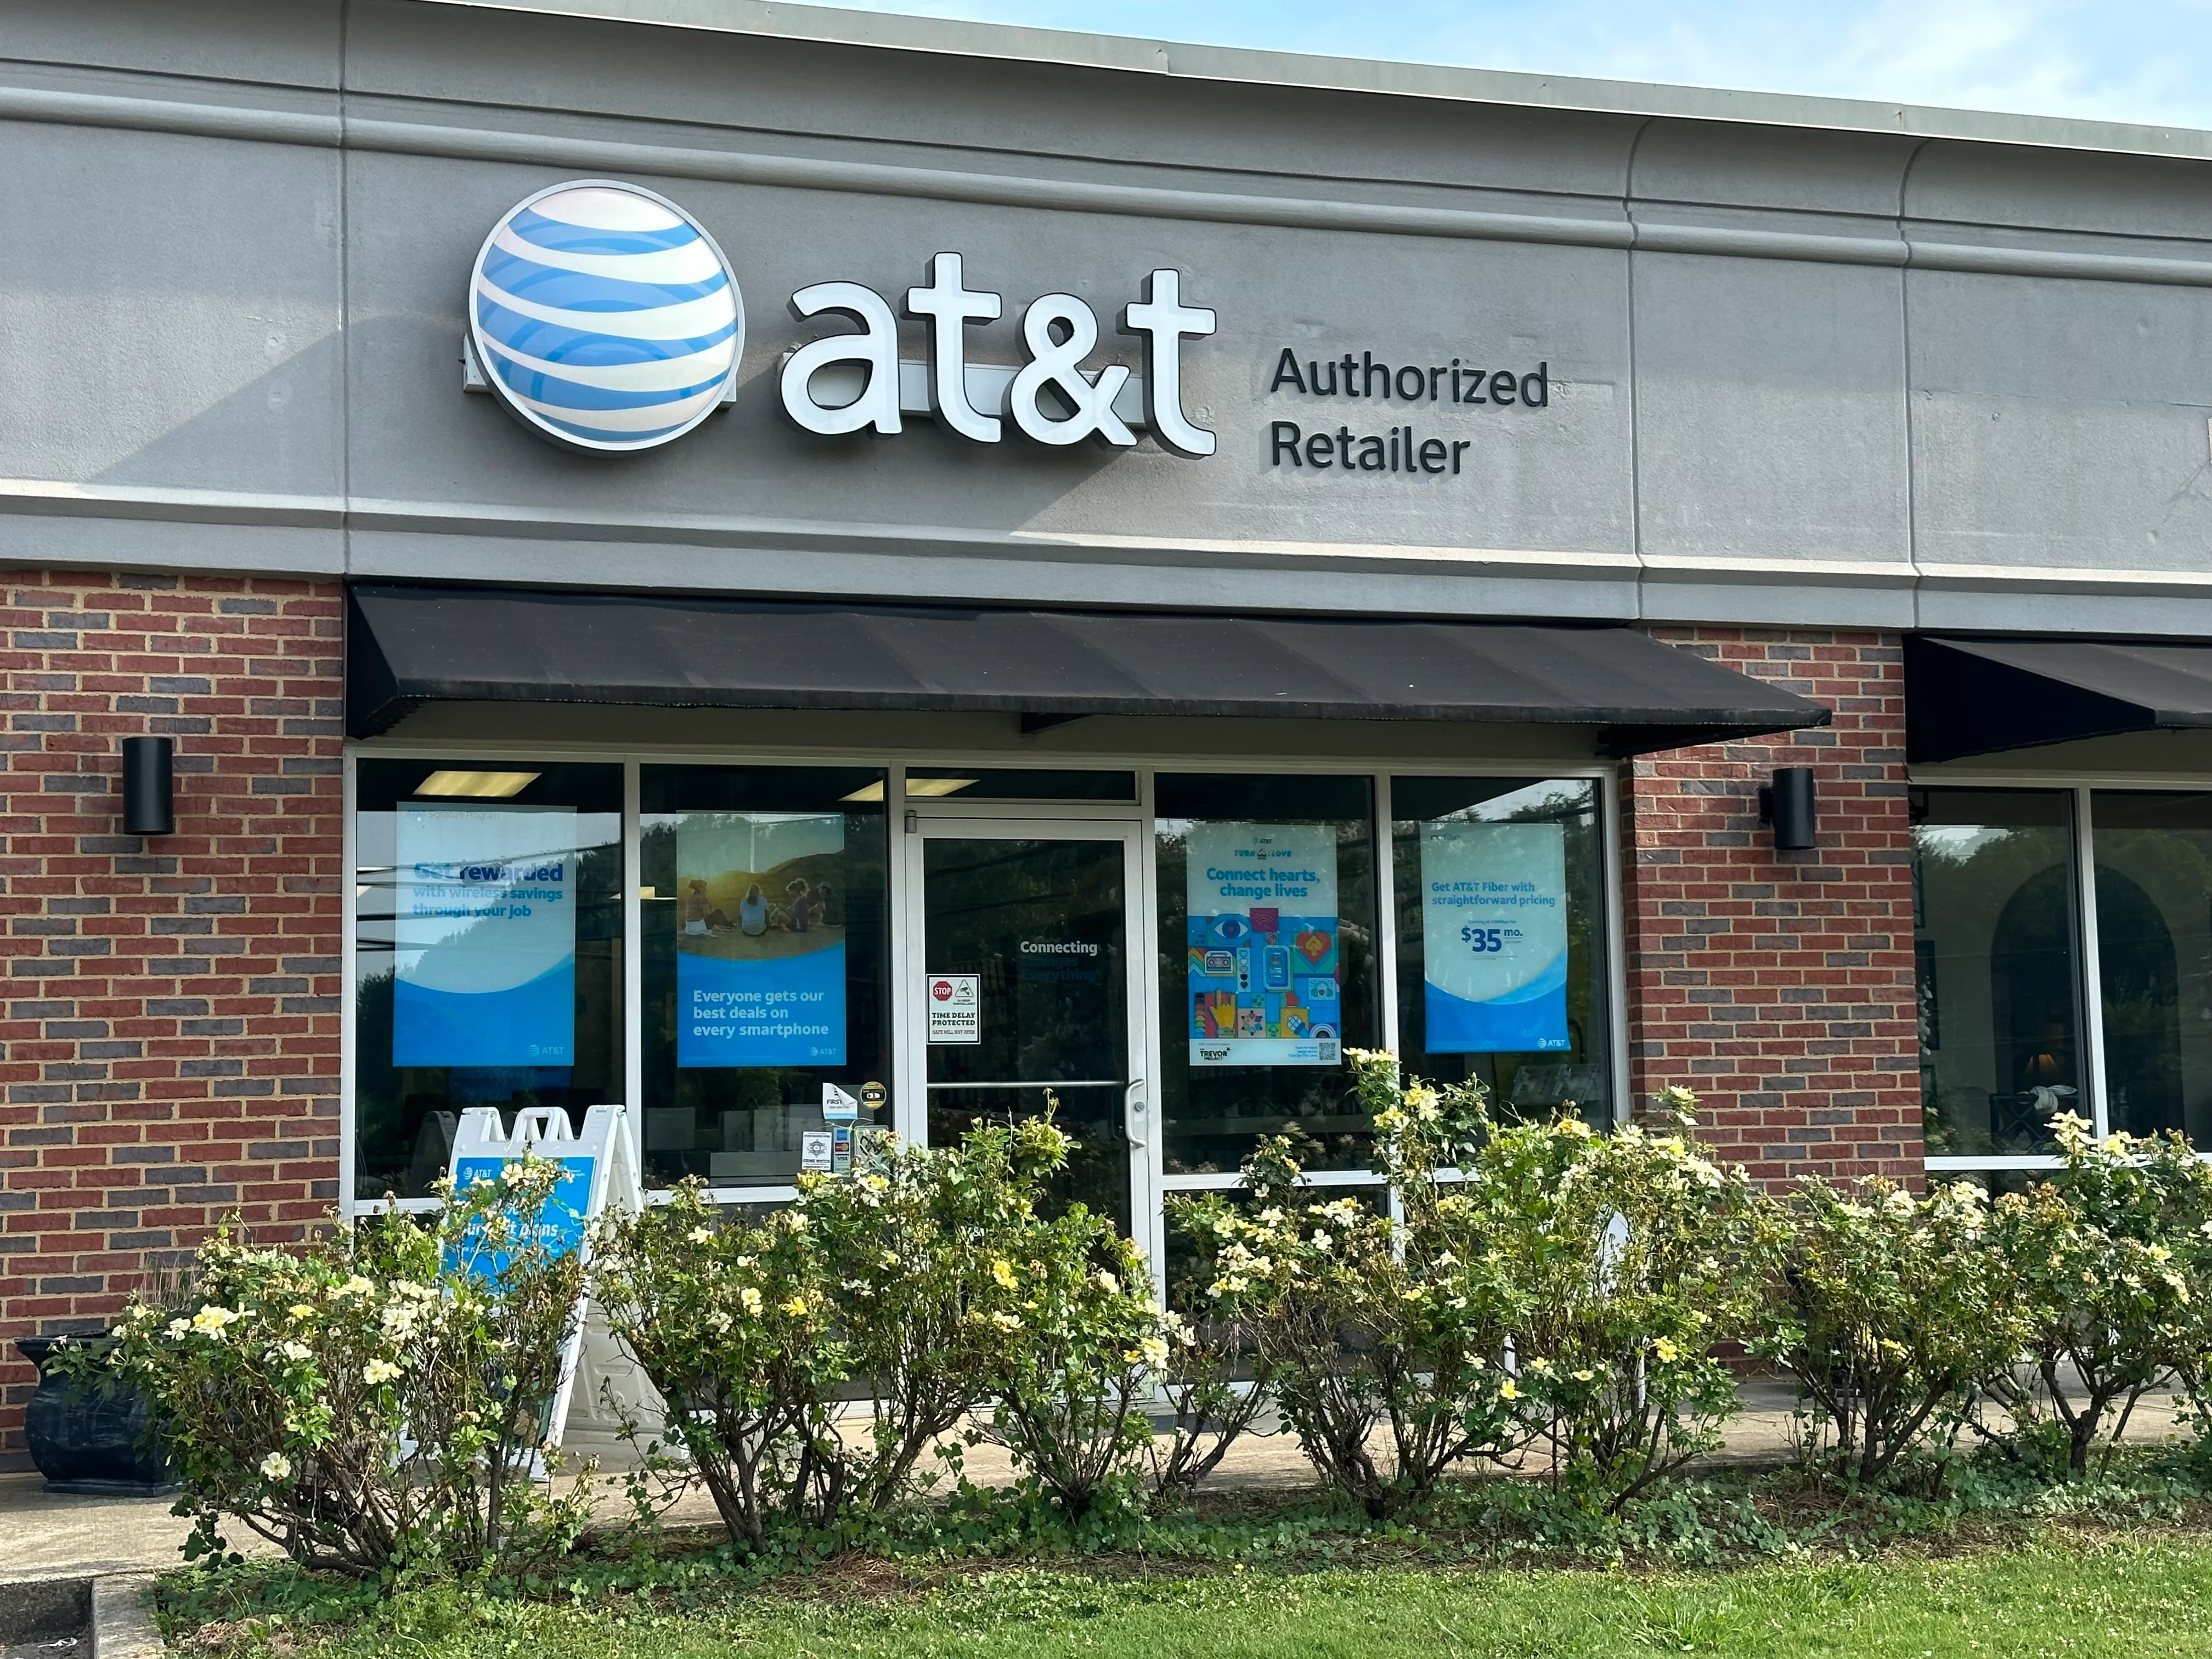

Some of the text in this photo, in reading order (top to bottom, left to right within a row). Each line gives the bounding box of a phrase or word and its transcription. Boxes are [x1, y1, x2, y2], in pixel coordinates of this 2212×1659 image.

[780, 251, 1217, 458] at&t
[1270, 347, 1548, 407] Authorized
[1271, 420, 1471, 475] Retailer
[460, 864, 563, 881] rewarded
[1206, 867, 1320, 884] Connect hearts,
[414, 885, 563, 902] with wireless savings
[1220, 883, 1308, 900] change lives
[1431, 882, 1535, 891] Get AT&T Fiber with
[1432, 895, 1555, 907] straightforward pricing
[413, 904, 532, 919] through your job
[1020, 940, 1098, 956] Connecting
[693, 990, 825, 1005] Everyone gets our
[934, 987, 951, 995] STOP
[693, 1006, 788, 1019] best deals on
[693, 1023, 829, 1039] every smartphone
[541, 1046, 565, 1055] AT&T
[473, 1169, 492, 1178] AT&T
